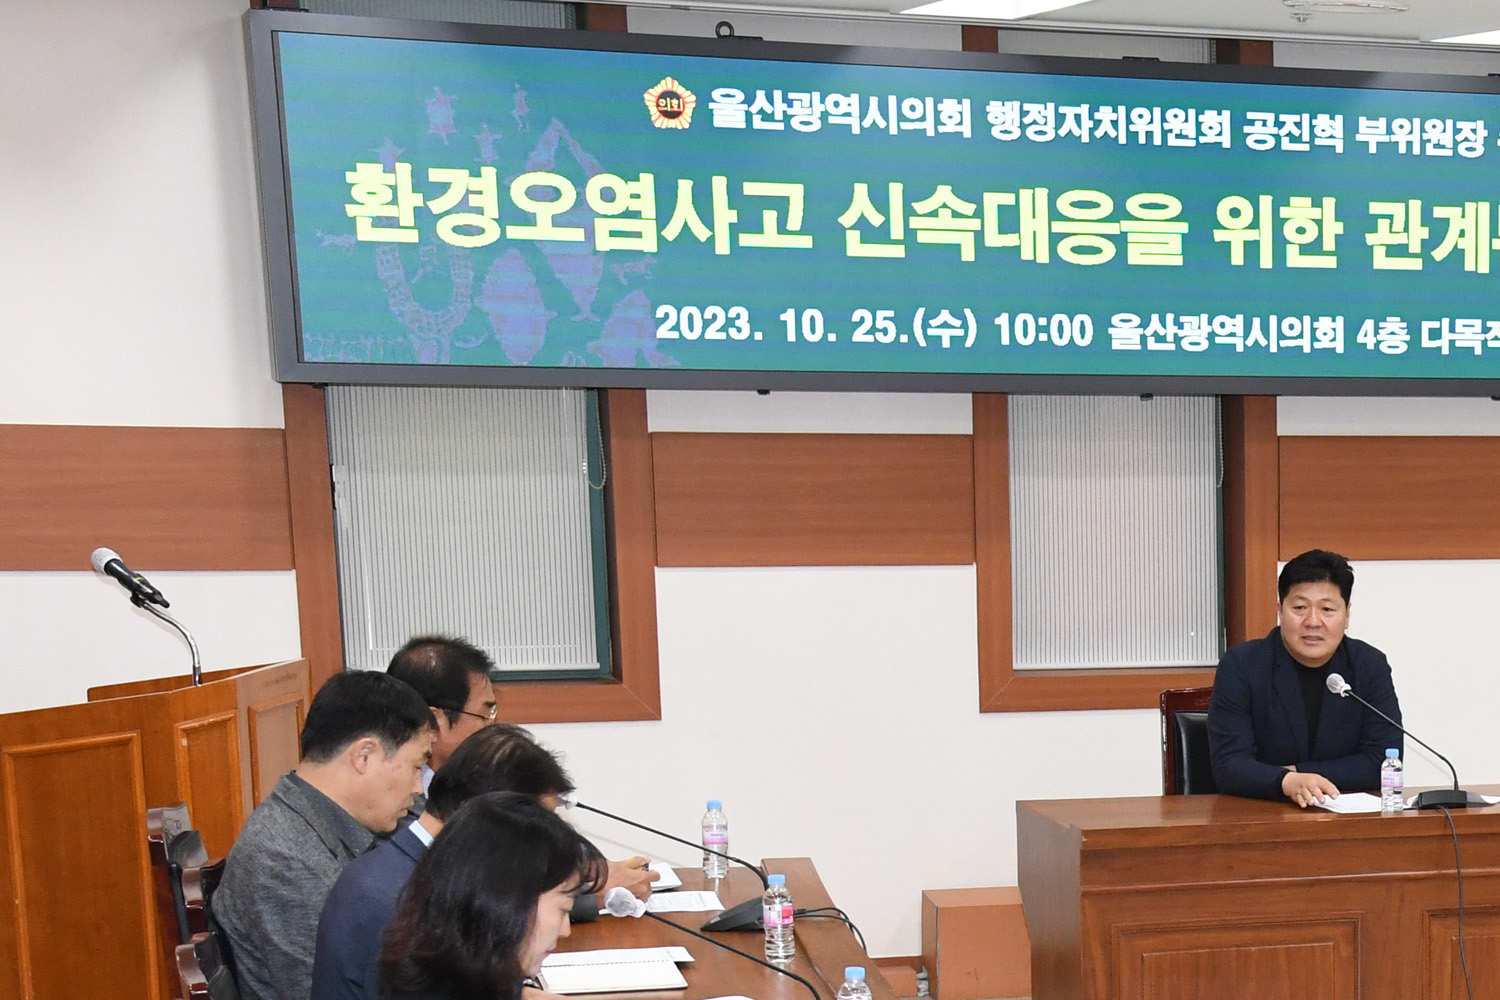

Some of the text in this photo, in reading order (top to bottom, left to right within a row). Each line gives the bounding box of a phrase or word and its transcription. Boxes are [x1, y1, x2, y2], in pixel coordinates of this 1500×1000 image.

[658, 97, 683, 111] 의회
[709, 88, 971, 138] 울산광역시의회
[986, 101, 1230, 148] 행정자치위원회
[1244, 111, 1343, 153] 공진혁
[1356, 117, 1488, 158] 부위원장
[345, 162, 812, 254] 환경오염사고
[838, 183, 1188, 265] 신속대응을
[1213, 195, 1343, 268] 위한
[656, 305, 762, 341] 2023.
[780, 309, 836, 343] 10.
[852, 308, 977, 348] 25.(수)
[995, 313, 1093, 347] 10:00
[1108, 313, 1344, 353] 울산광역시의회
[1357, 317, 1410, 354] 4층
